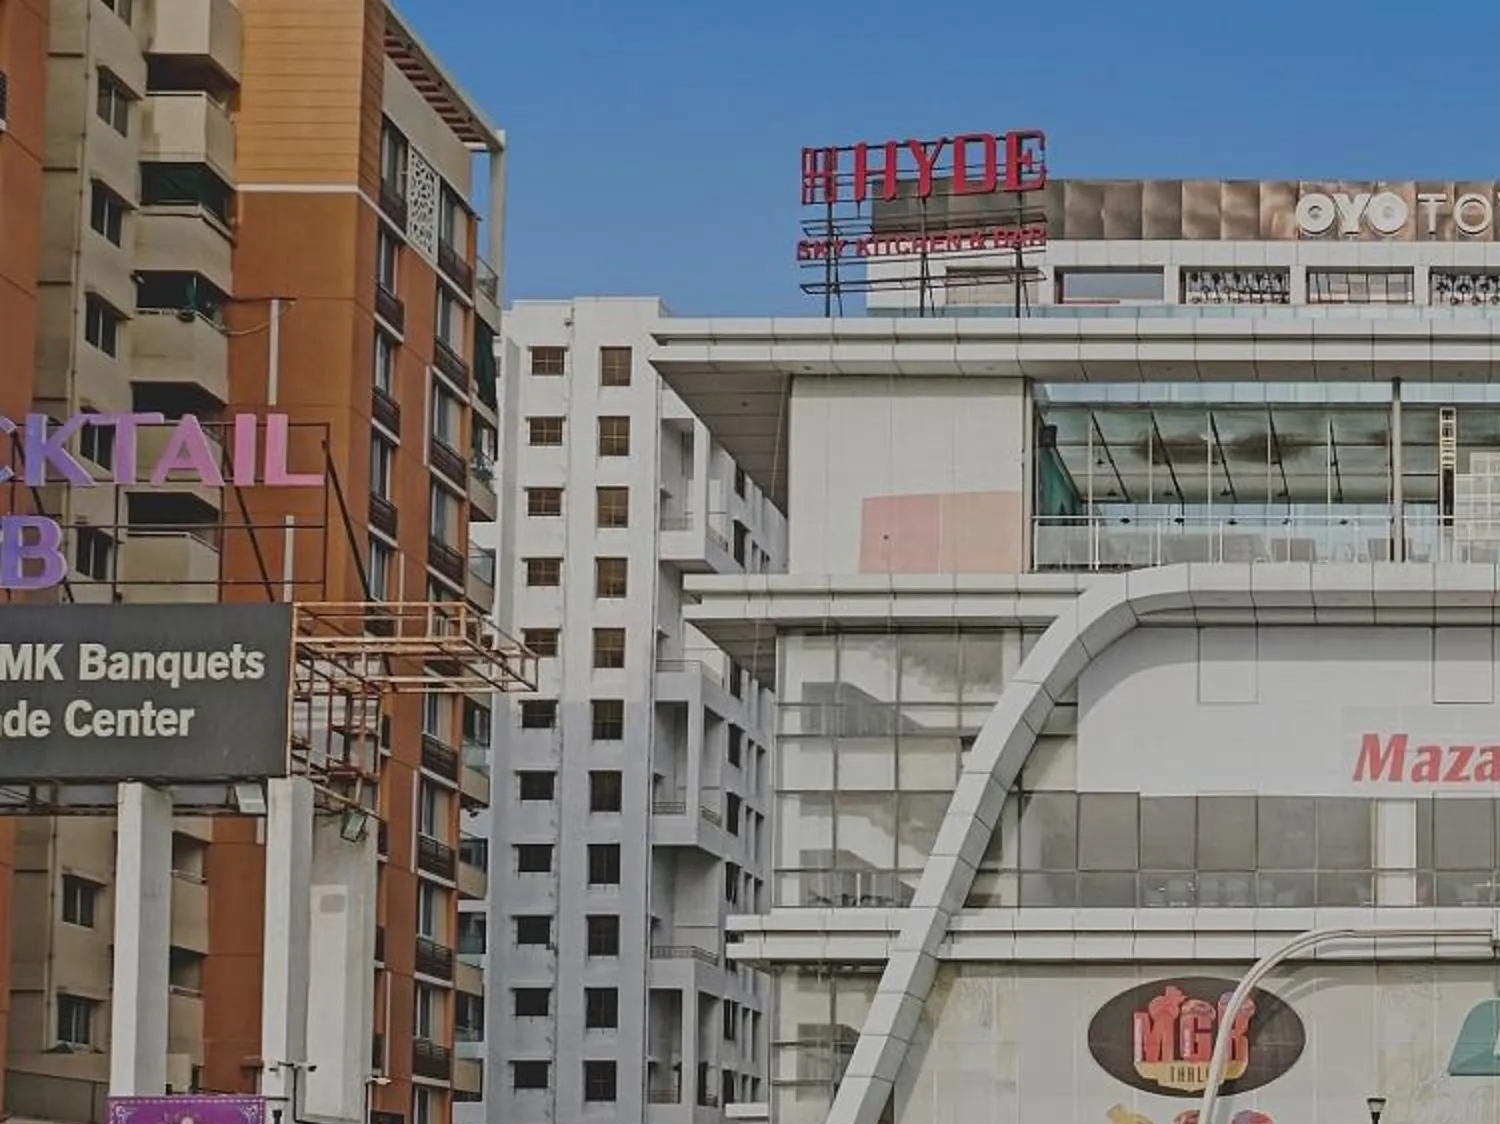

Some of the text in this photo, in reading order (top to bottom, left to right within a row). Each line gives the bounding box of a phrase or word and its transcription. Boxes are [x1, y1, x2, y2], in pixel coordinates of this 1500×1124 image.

[1296, 191, 1408, 235] OYO
[79, 642, 265, 688] Banquets
[64, 699, 195, 738] Center
